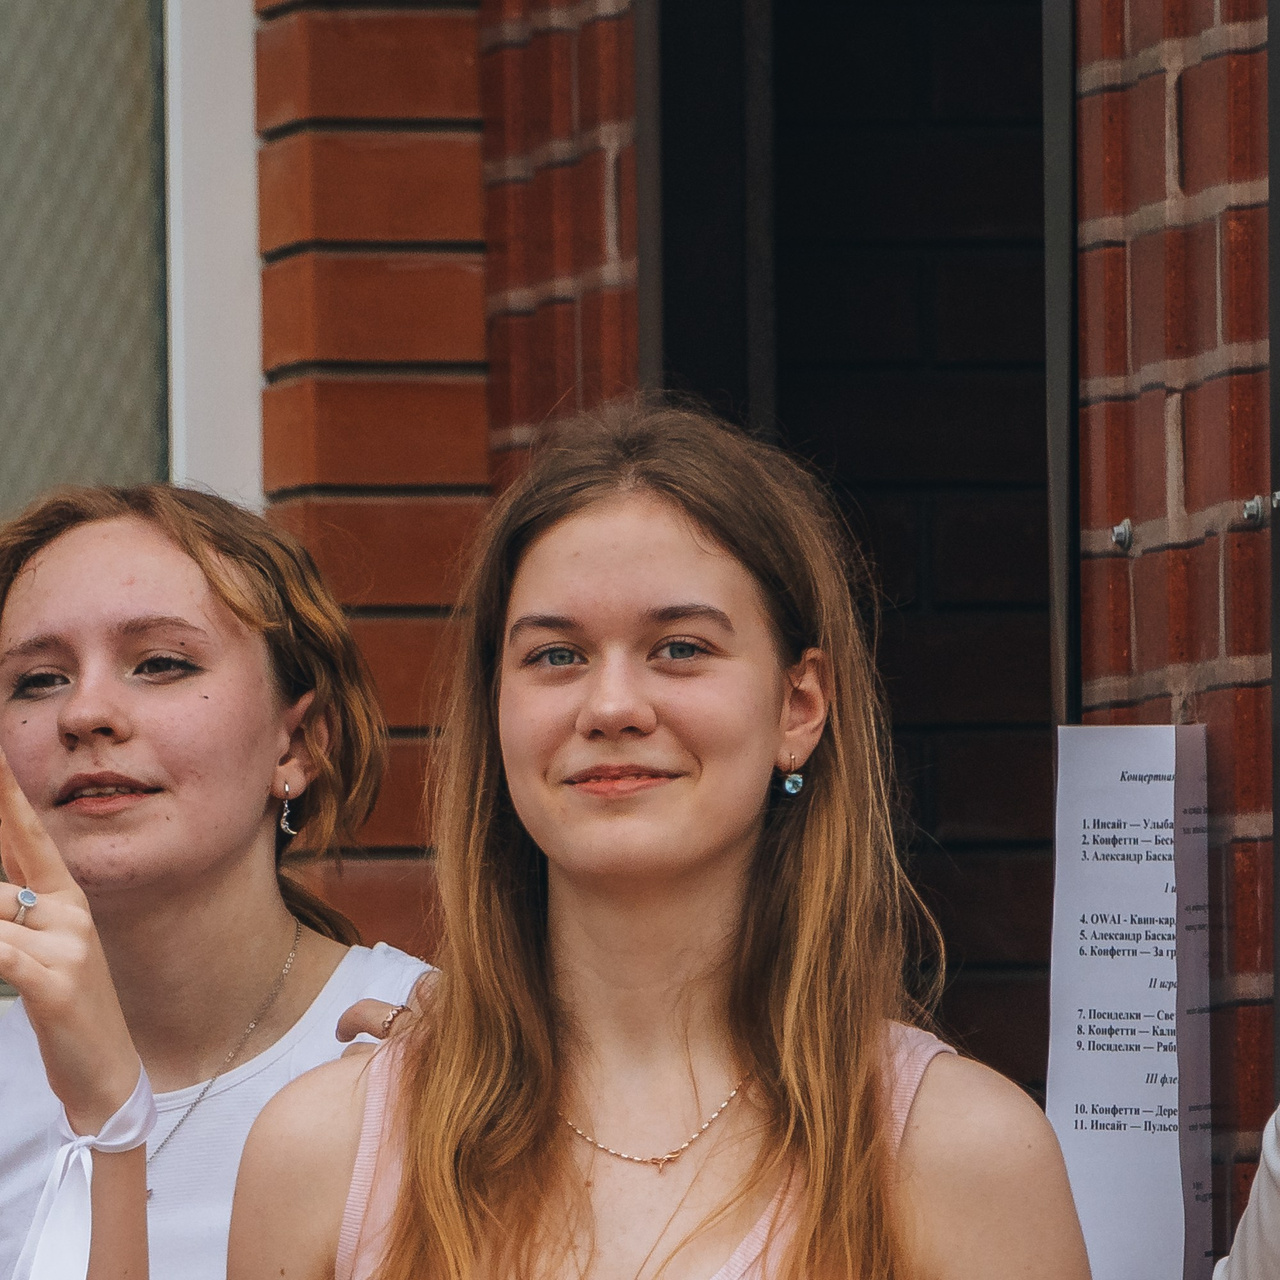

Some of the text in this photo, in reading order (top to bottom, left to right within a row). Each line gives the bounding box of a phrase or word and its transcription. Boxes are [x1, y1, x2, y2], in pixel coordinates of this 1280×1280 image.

[1093, 818, 1127, 830] Инсайт
[1143, 819, 1174, 830] Улыба
[1093, 834, 1139, 848] Конфетти
[1092, 850, 1143, 864] Александр
[1146, 851, 1174, 861] Баска
[1091, 929, 1142, 944] Александр
[1090, 945, 1138, 959] Конфетти
[1088, 1008, 1141, 1021] Посиделки
[1088, 1024, 1136, 1038] Конфетти
[1087, 1040, 1141, 1052] Посиделки
[1091, 1103, 1140, 1118] Конфетти
[1090, 1119, 1127, 1131] Инсайт
